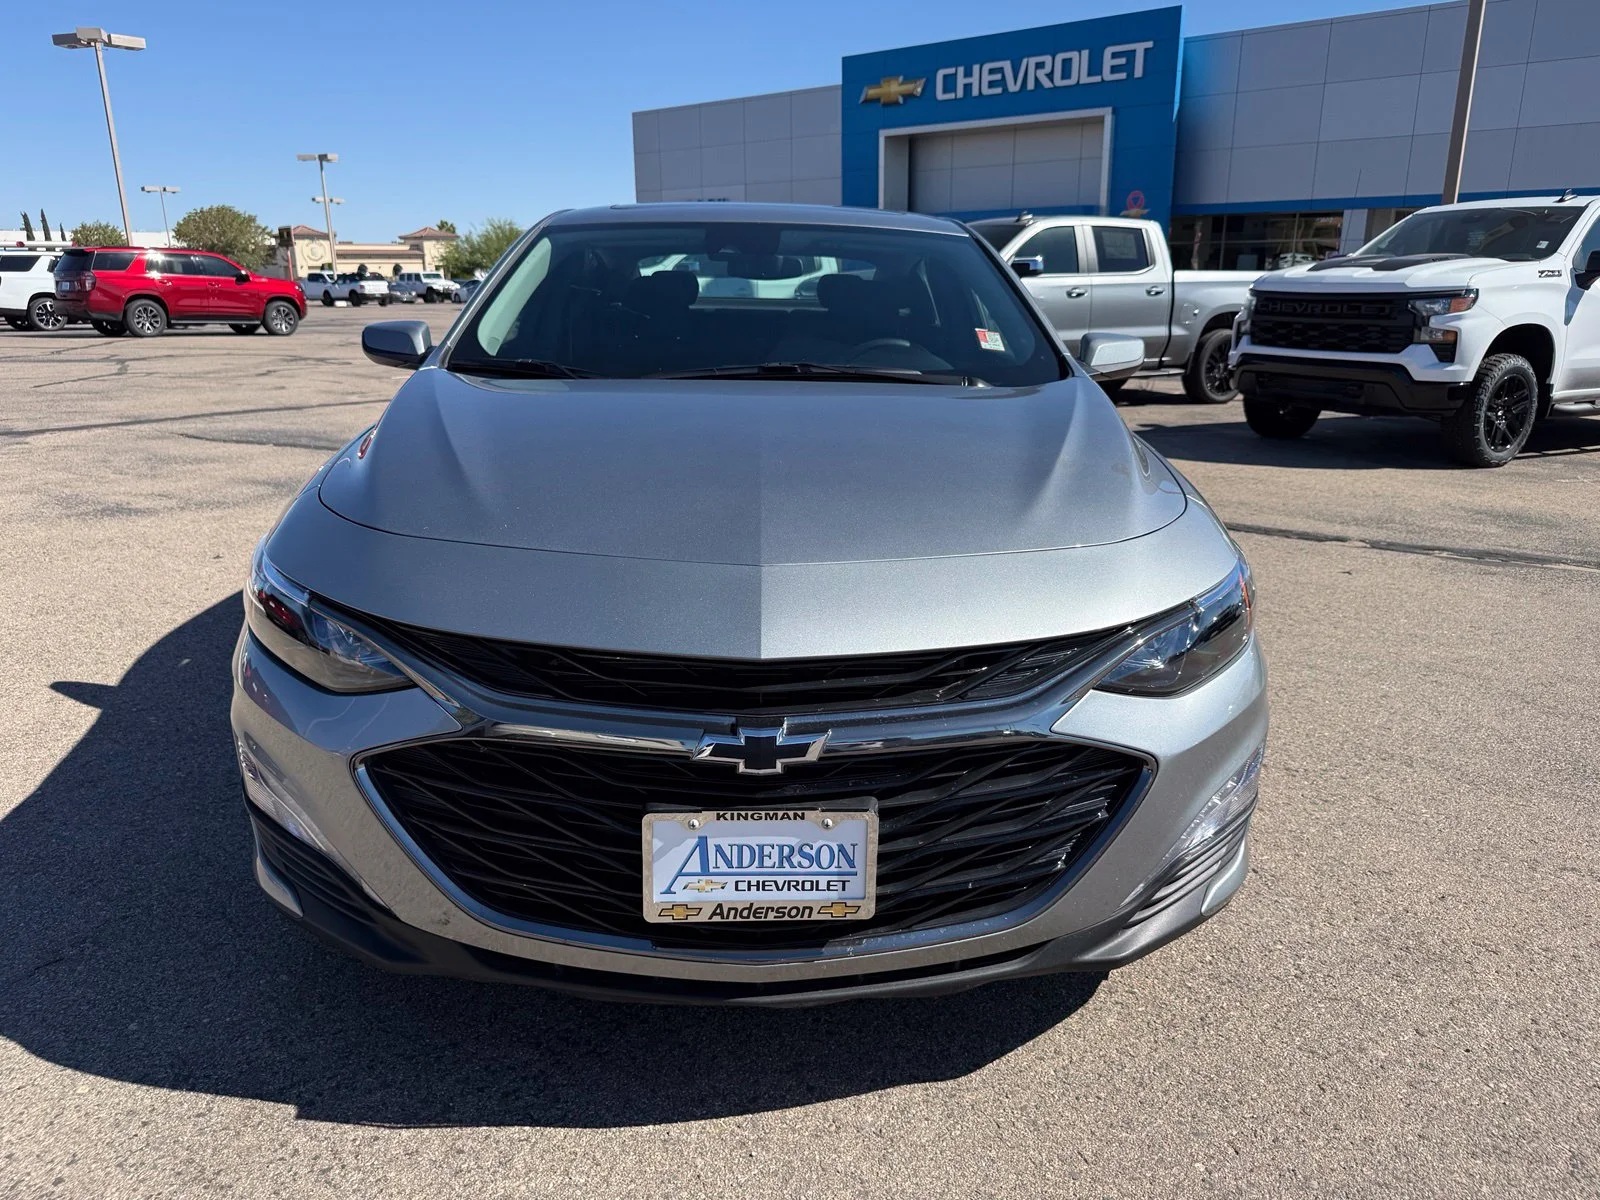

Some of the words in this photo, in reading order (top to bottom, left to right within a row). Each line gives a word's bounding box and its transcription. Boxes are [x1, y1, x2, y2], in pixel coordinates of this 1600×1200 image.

[935, 41, 1154, 101] CHEVROLET
[1258, 302, 1393, 316] CHEVROLET
[716, 812, 806, 821] KINGMAN
[660, 835, 858, 894] ANDERSON
[734, 879, 851, 892] CHEVROLET
[708, 903, 814, 920] Anderson
